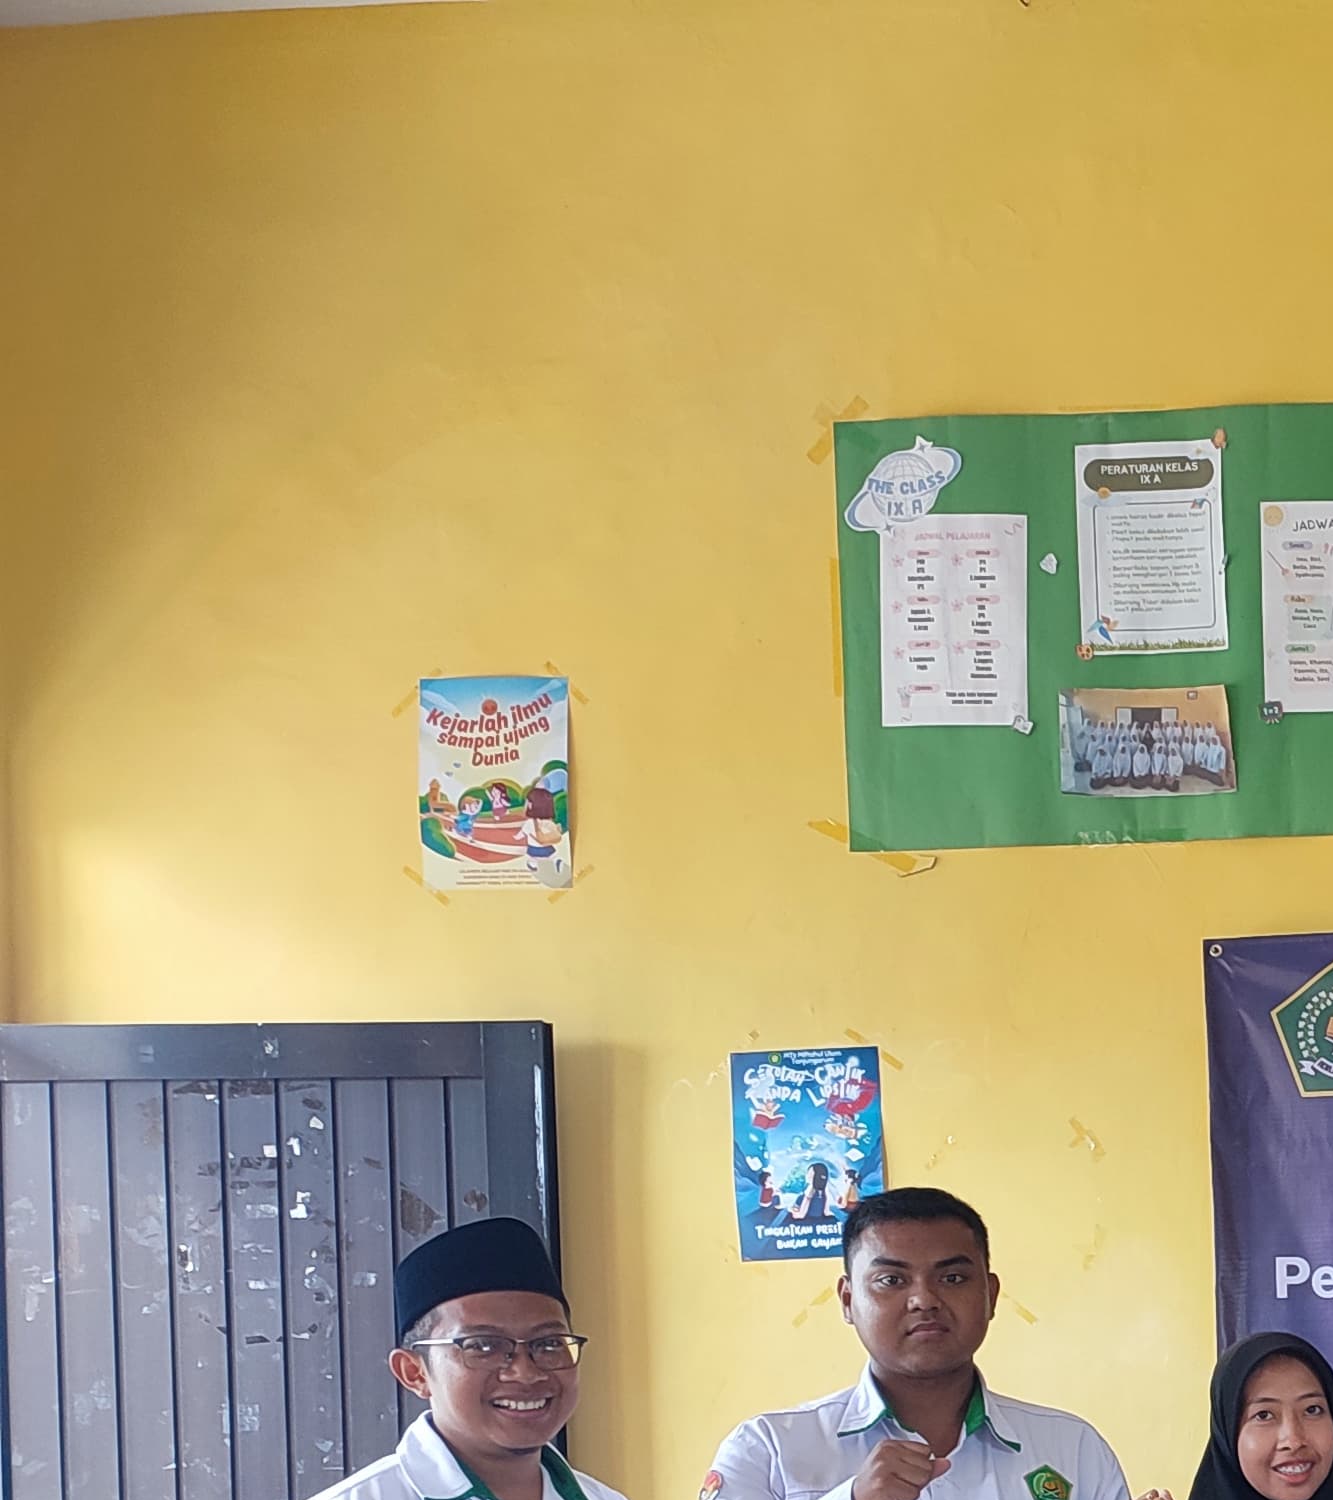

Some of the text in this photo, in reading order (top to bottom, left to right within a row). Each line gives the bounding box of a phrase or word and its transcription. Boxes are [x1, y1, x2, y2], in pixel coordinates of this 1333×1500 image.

[1100, 461, 1199, 475] PERATURAN KELAS
[868, 471, 945, 495] THE CLASS
[1140, 474, 1161, 485] IX A
[887, 499, 923, 516] IX A
[426, 693, 553, 736] Kejarlah ilmu
[437, 715, 550, 751] sampai ujung
[472, 749, 520, 767] Dunia
[816, 1221, 843, 1235] PREST
